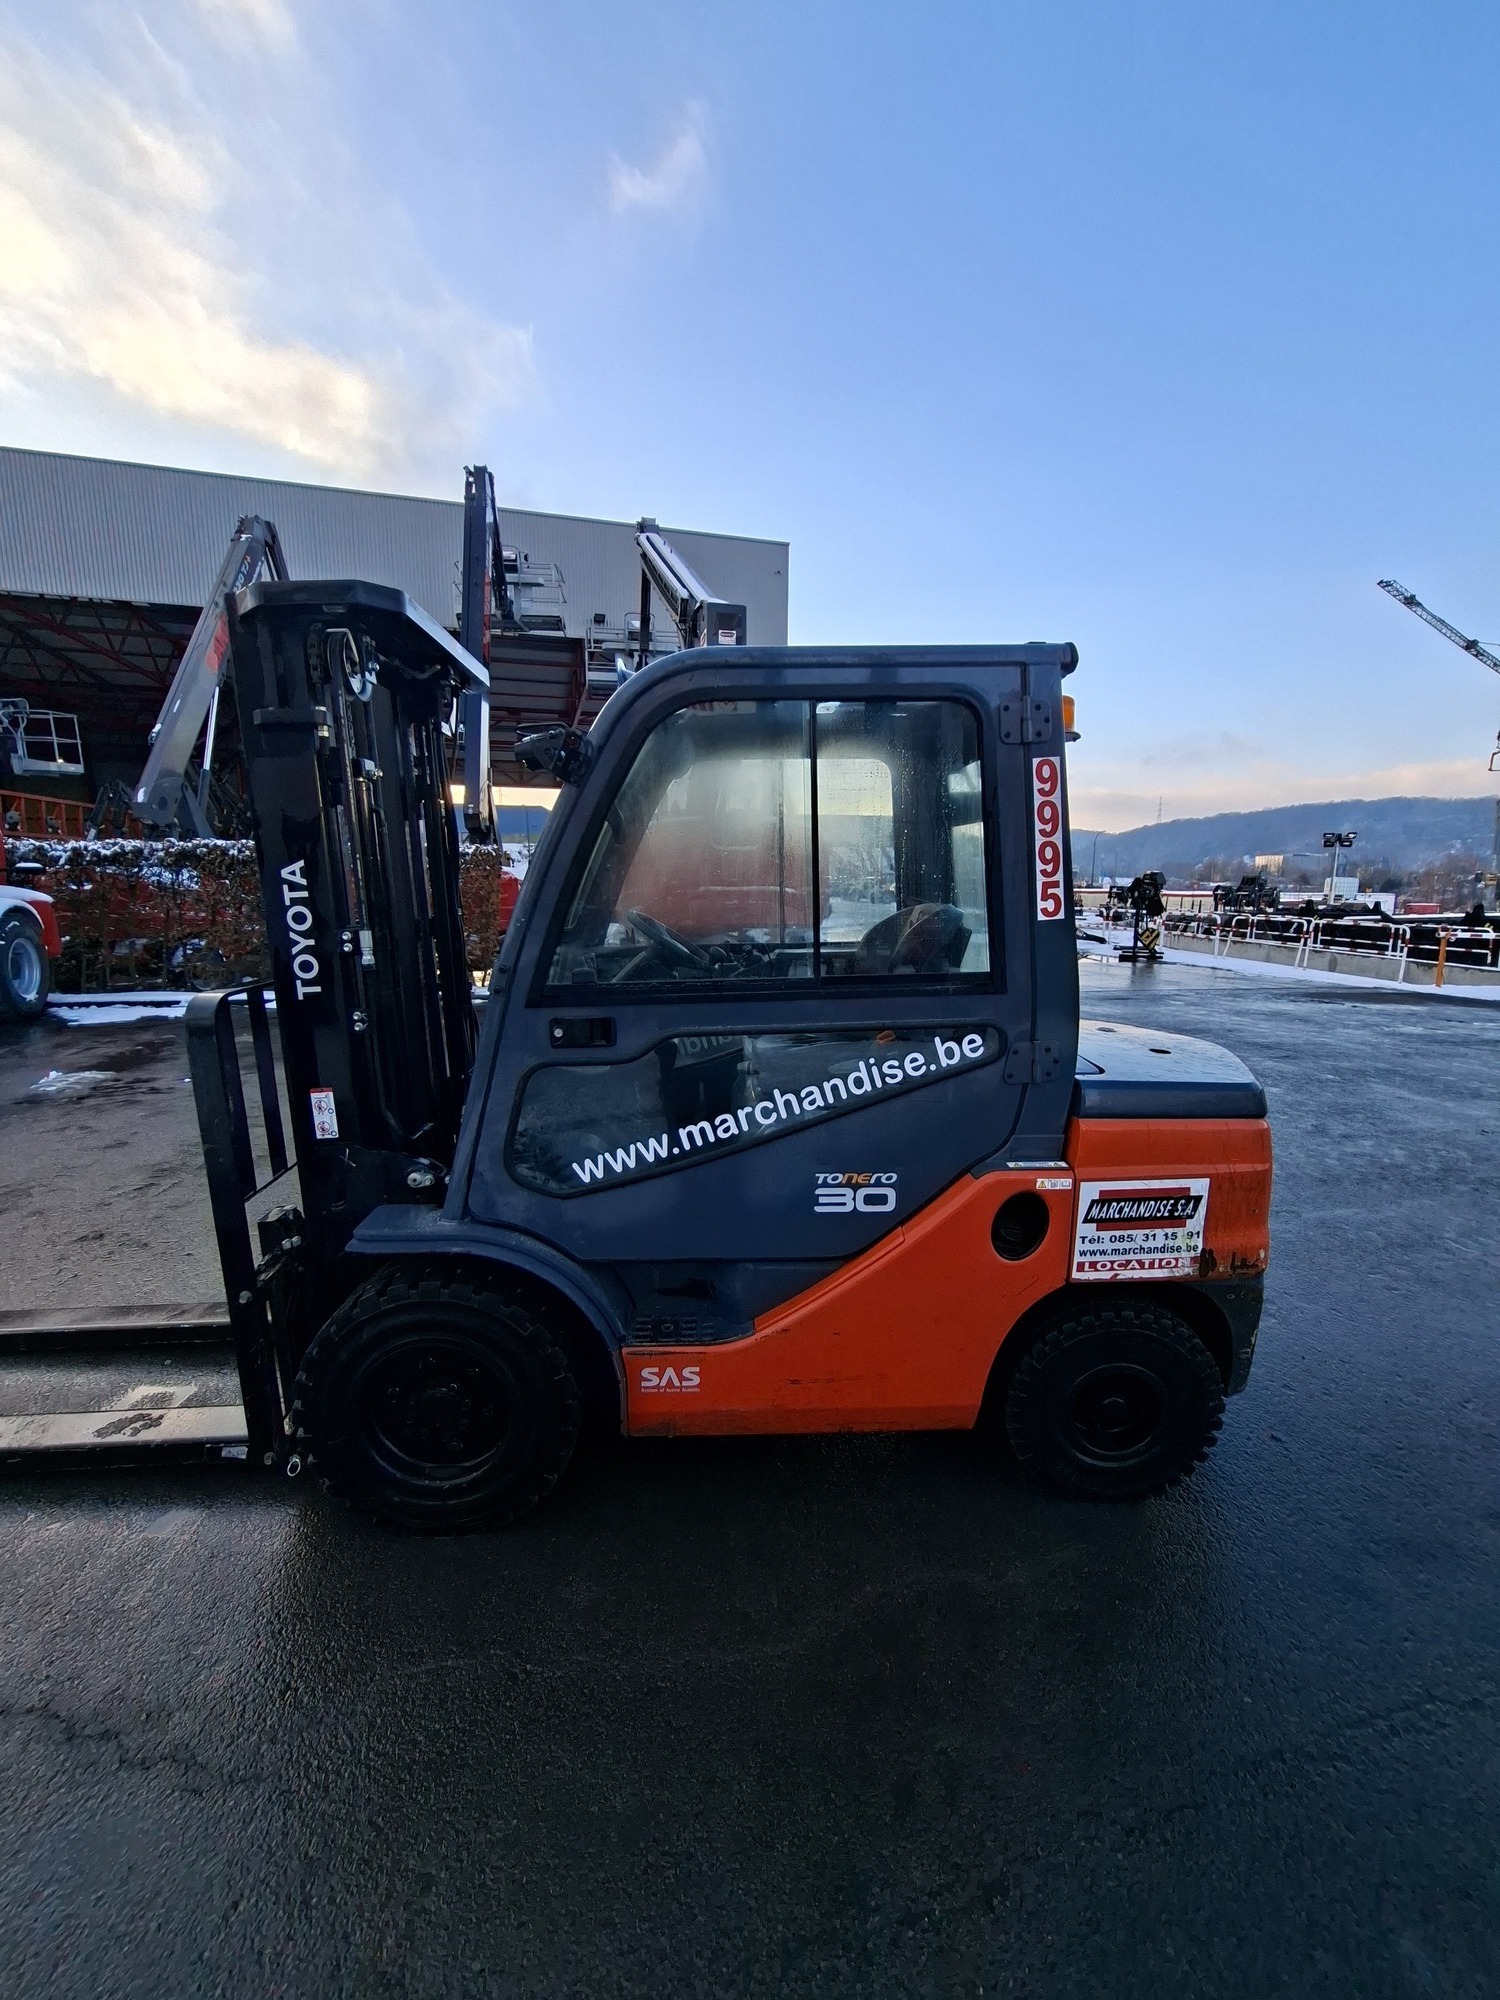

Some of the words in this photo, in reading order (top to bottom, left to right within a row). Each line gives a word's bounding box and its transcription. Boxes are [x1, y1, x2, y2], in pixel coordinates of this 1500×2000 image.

[1035, 758, 1062, 918] 9995
[280, 859, 322, 1000] TOYOTA
[572, 1033, 984, 1183] www.marchandise.be
[814, 1187, 896, 1212] 30
[1087, 1199, 1174, 1219] MARCHANDISE
[1174, 1199, 1195, 1216] S.A.
[1079, 1235, 1105, 1245] Tél:
[1141, 1232, 1157, 1242] 31
[1163, 1231, 1178, 1241] 15
[1186, 1230, 1201, 1240] 91
[1078, 1242, 1199, 1257] www.marchandise.be
[1083, 1258, 1191, 1272] LOCATION
[641, 1366, 700, 1387] SAS
